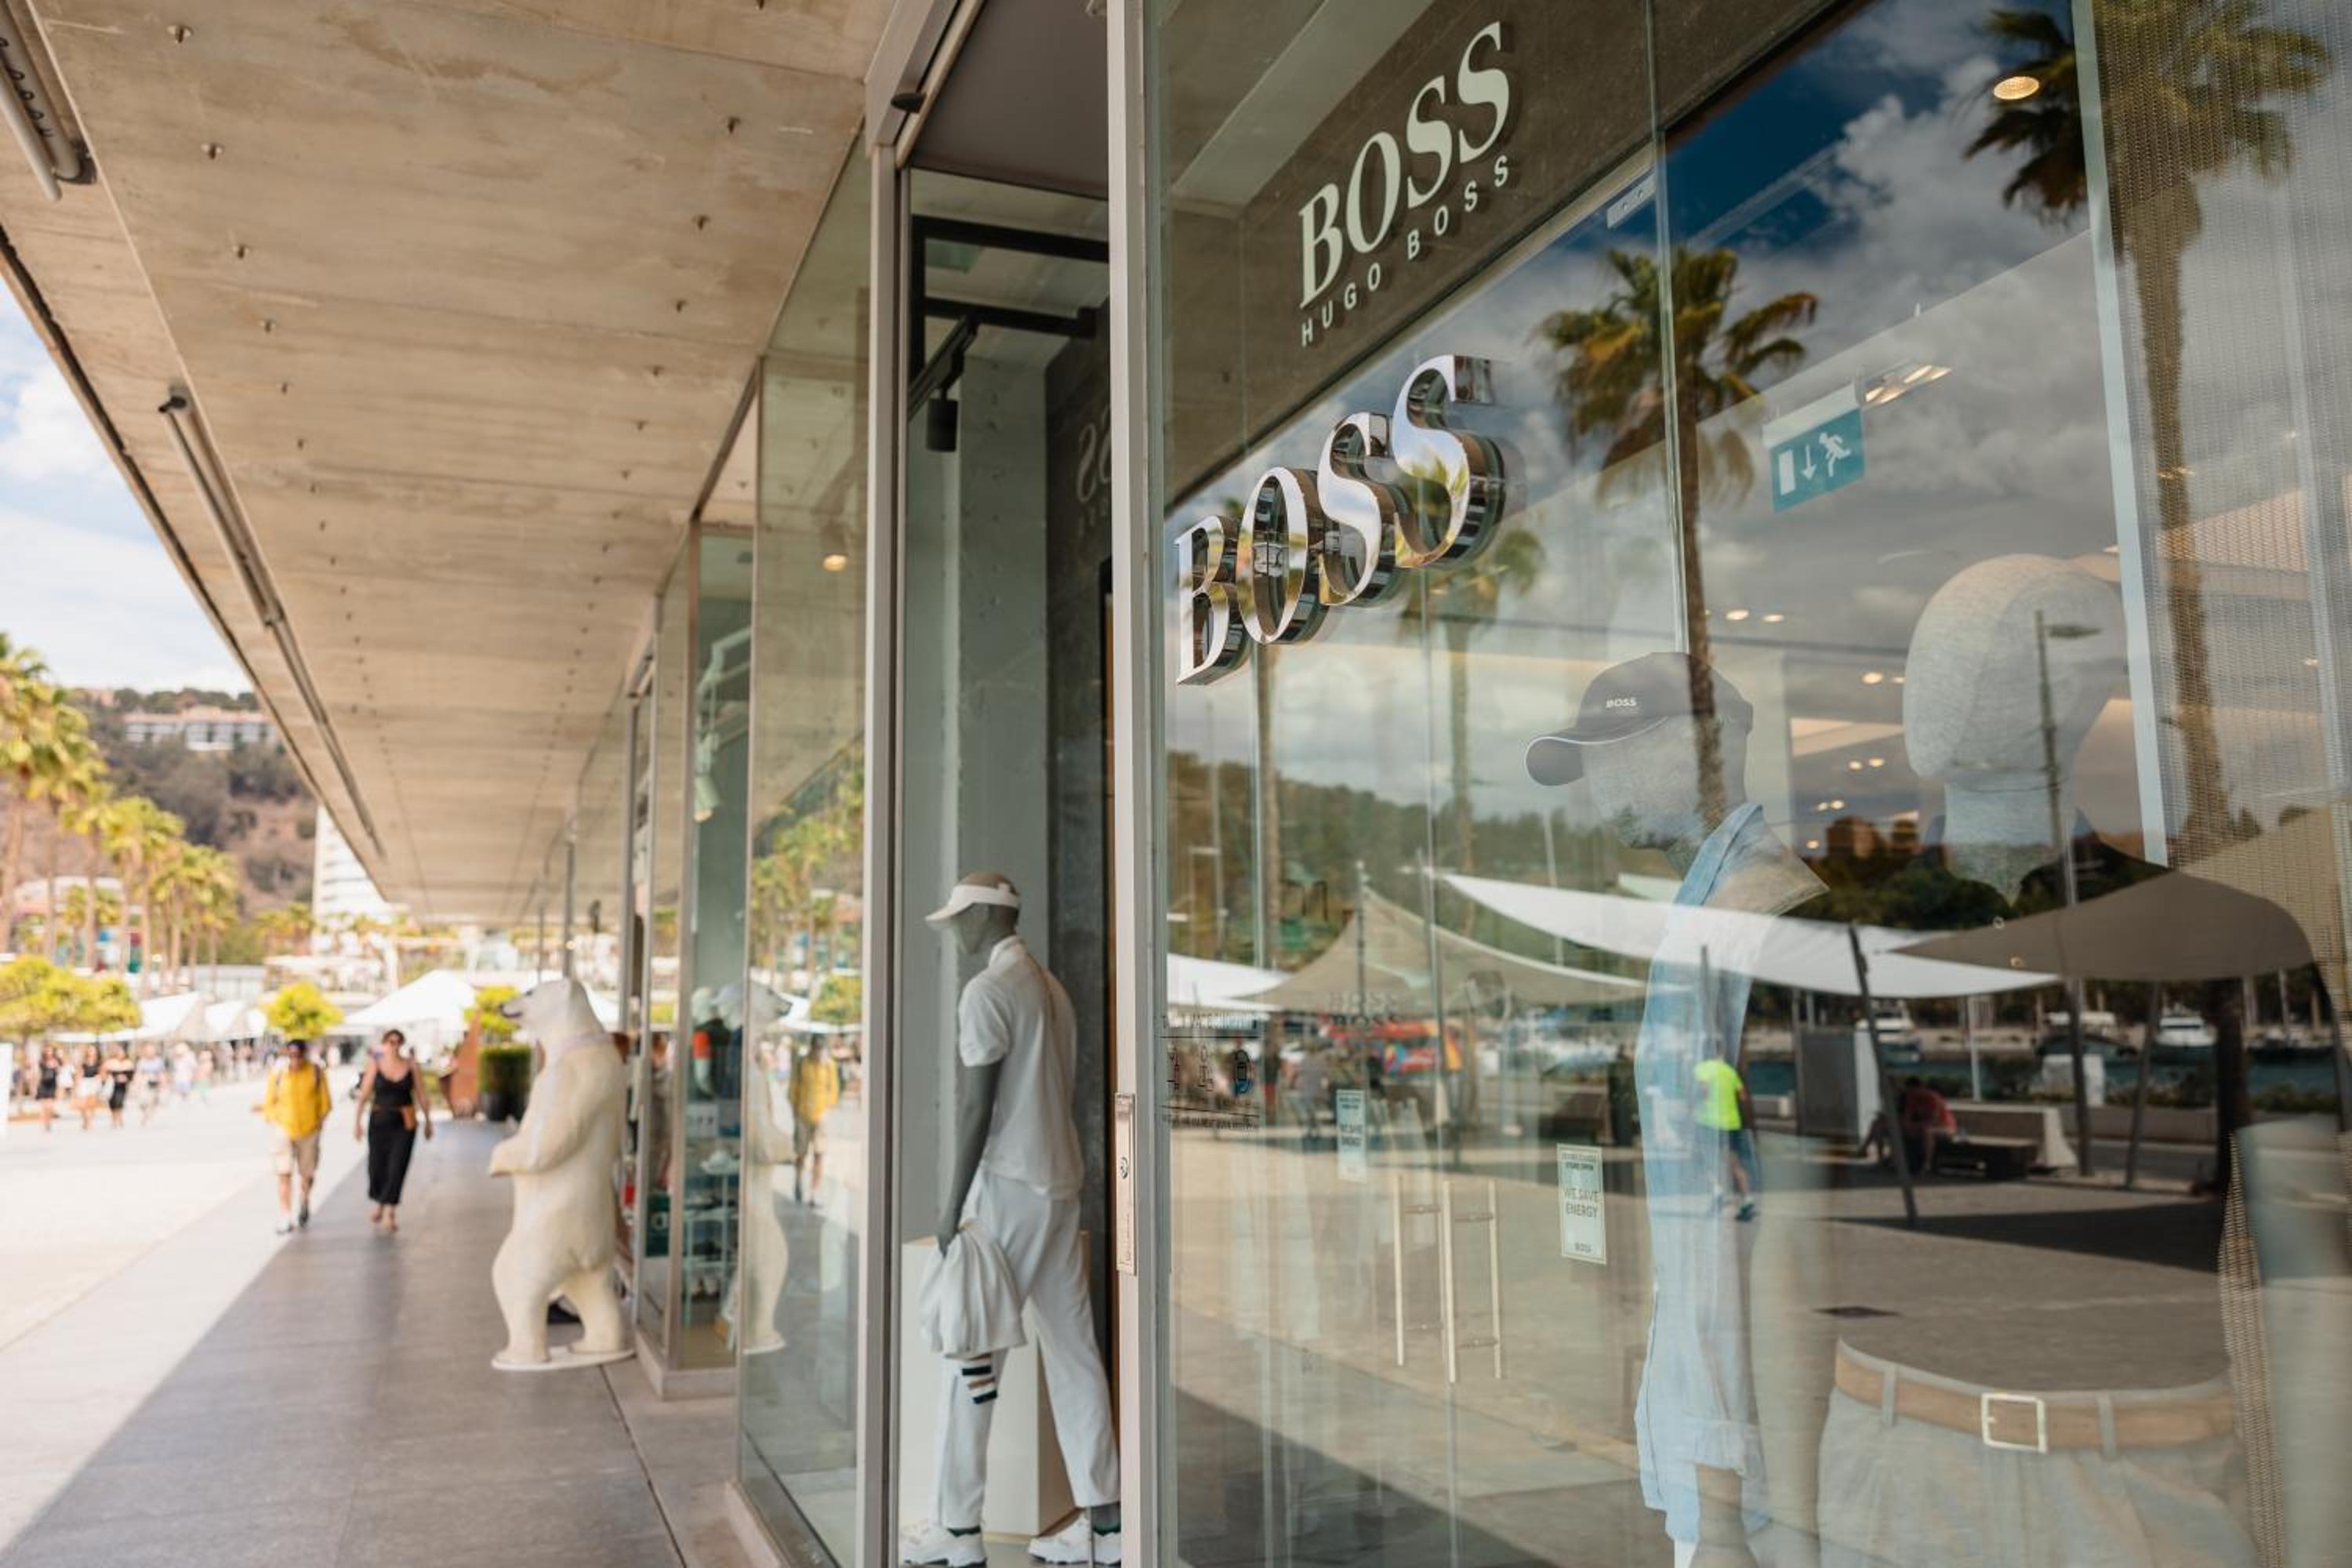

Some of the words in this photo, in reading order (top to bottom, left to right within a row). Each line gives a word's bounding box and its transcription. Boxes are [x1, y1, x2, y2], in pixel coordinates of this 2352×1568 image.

[1298, 21, 1510, 310] BOSS
[1301, 263, 1381, 347] HUGO
[1407, 154, 1508, 261] BOSS
[1174, 354, 1494, 684] BOSS
[1606, 697, 1637, 708] BOSS
[1566, 1202, 1598, 1218] ENERGY
